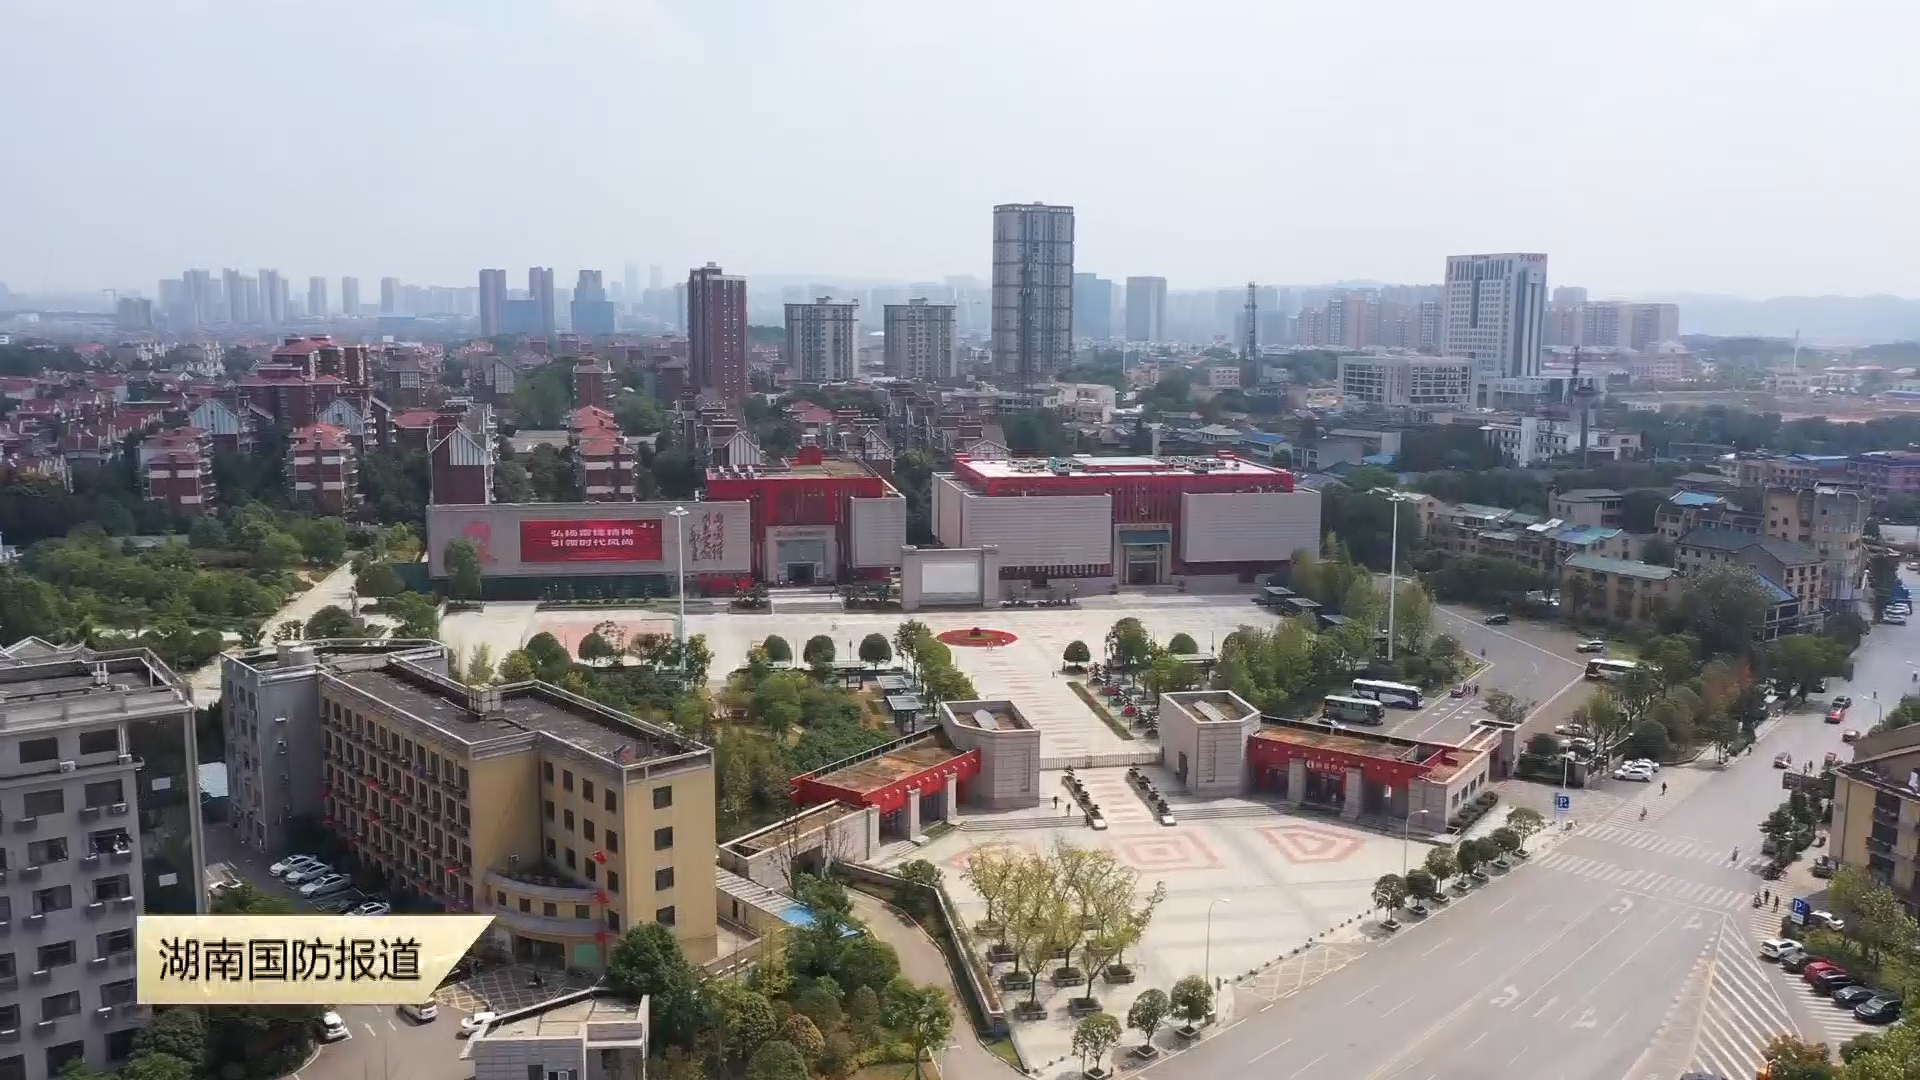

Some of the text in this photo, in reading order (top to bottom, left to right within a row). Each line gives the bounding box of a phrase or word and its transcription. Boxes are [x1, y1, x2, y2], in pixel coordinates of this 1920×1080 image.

[551, 538, 634, 547] 引领时代风尚
[1794, 900, 1802, 911] P
